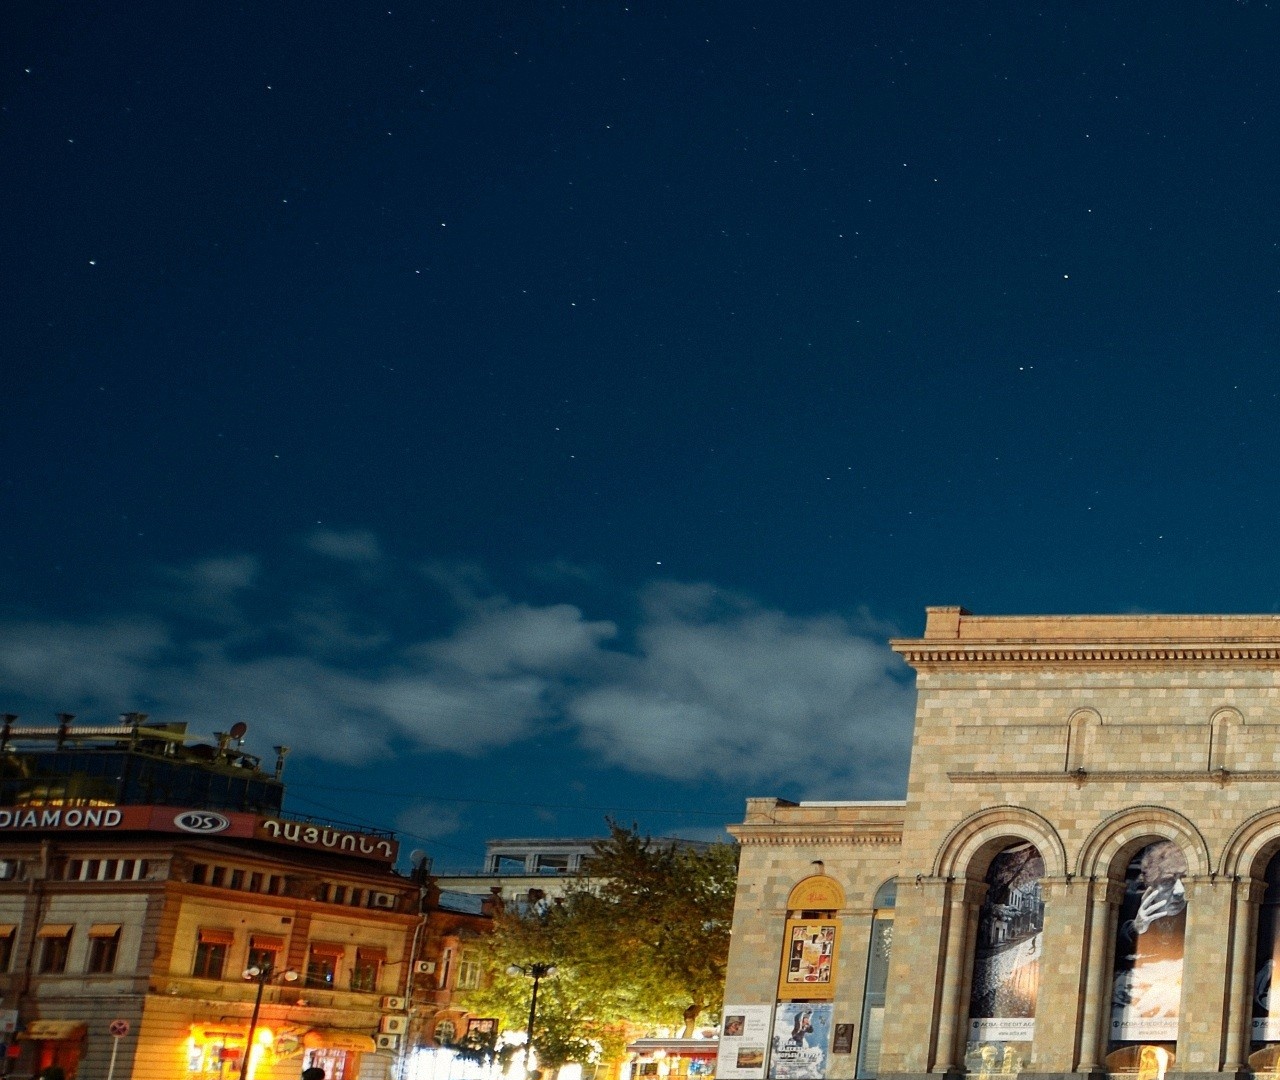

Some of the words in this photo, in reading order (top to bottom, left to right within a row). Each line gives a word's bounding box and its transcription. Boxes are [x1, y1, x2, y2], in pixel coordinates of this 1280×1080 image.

[0, 810, 122, 827] DIAMOND
[190, 815, 214, 829] DS
[263, 820, 393, 858] ԴԱՅՄՈՆԴ
